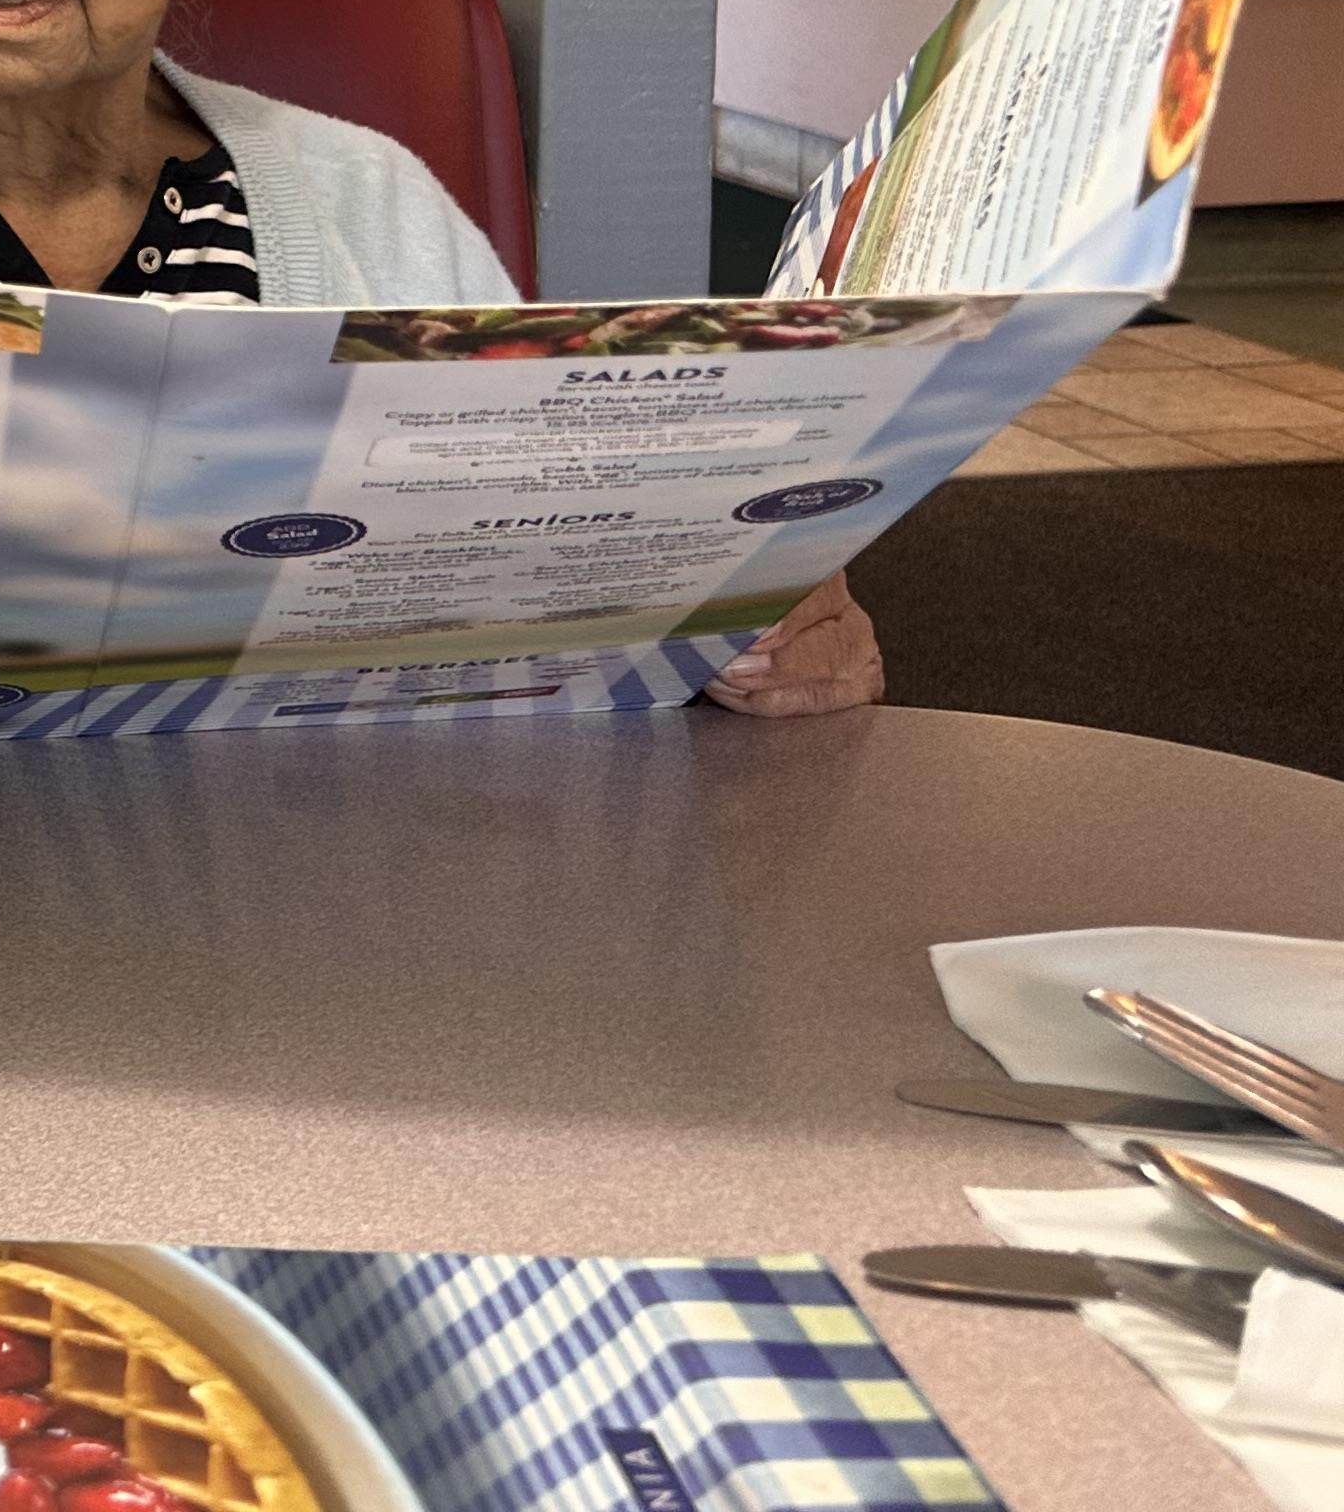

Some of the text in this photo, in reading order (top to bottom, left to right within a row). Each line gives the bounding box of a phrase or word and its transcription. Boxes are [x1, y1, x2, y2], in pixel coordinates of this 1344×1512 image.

[563, 366, 729, 384] SALADS
[539, 392, 724, 406] BBQ Salad
[385, 411, 434, 421] Crispy
[457, 408, 506, 419] grilled
[637, 402, 709, 411] tomatoes
[746, 396, 805, 406] cheddar
[400, 419, 453, 427] Topped
[493, 416, 538, 425] crispy
[656, 408, 697, 418] BBQ
[541, 462, 637, 474] Cobb Salad
[267, 528, 318, 540] Salad
[356, 654, 540, 675] BEVERAGES
